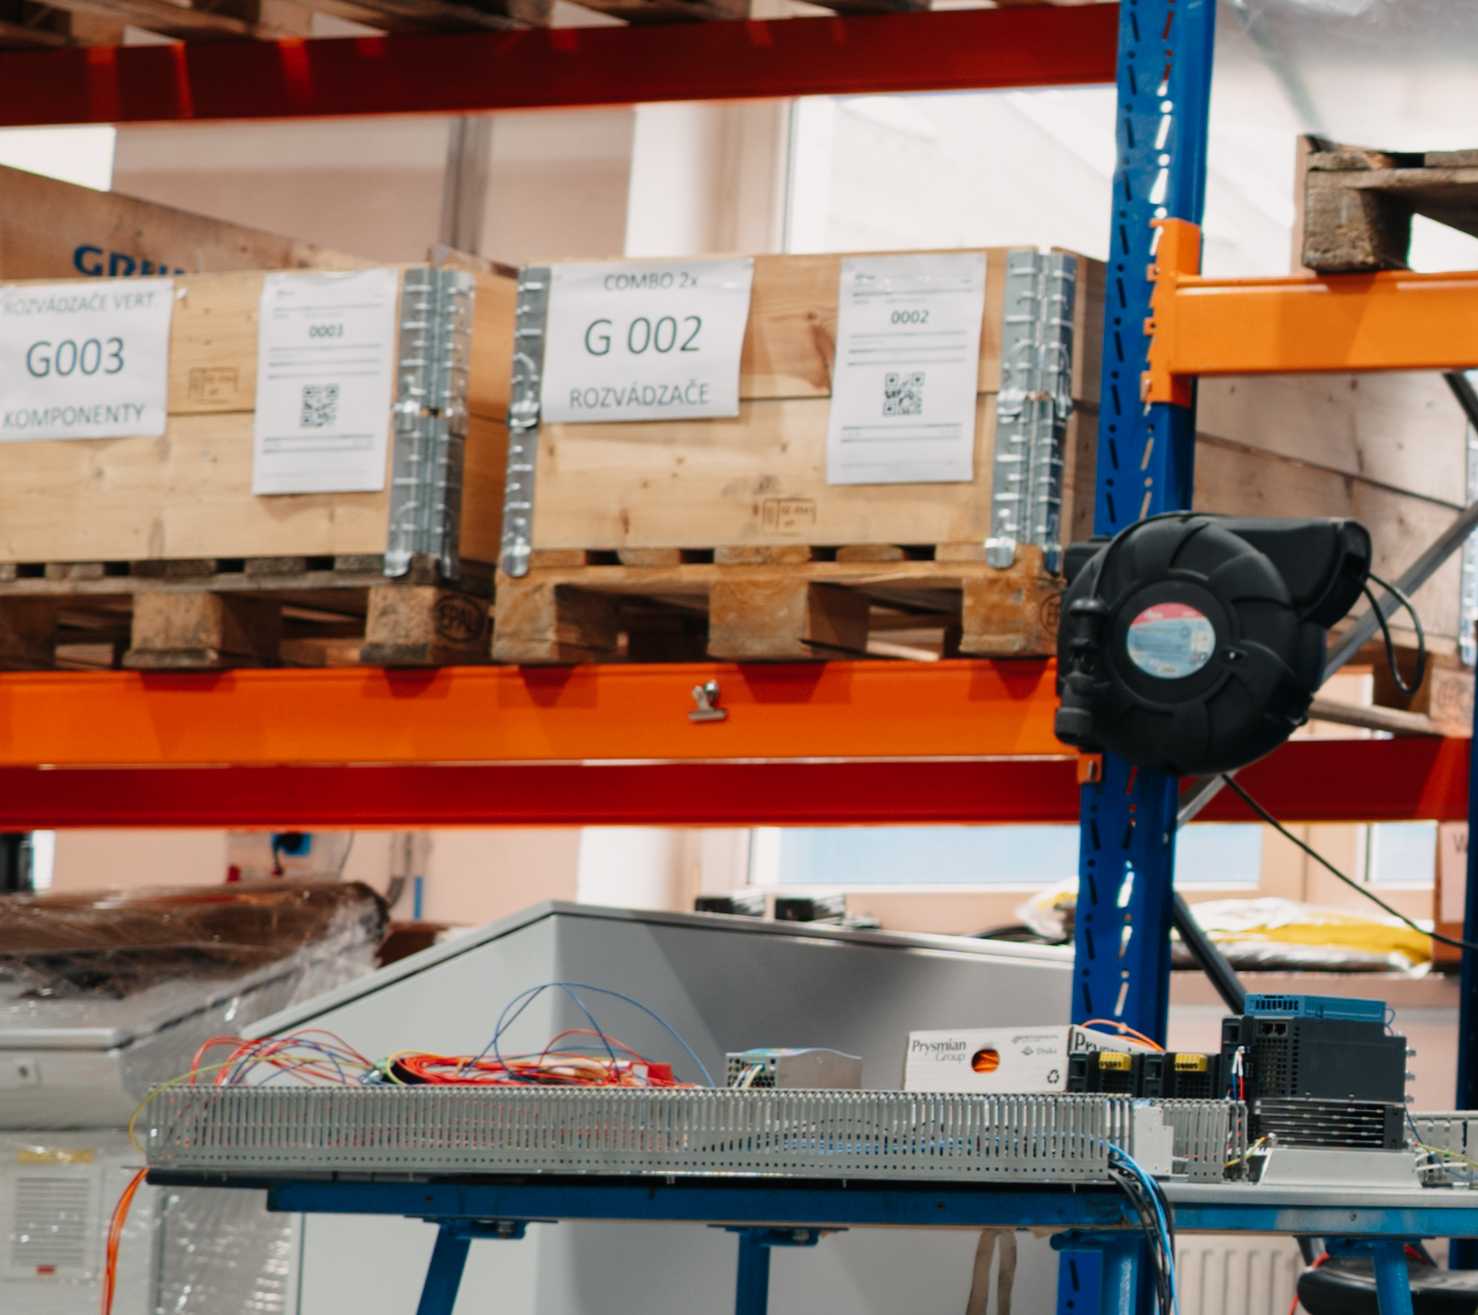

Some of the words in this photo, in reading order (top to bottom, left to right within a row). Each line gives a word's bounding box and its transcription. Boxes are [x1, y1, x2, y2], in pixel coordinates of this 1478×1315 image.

[603, 273, 675, 292] COMBO
[679, 272, 699, 289] 2x
[112, 291, 158, 311] VERT.
[890, 310, 930, 324] 0002
[309, 323, 344, 338] 0003
[584, 318, 612, 357] G
[627, 315, 703, 355] 002
[26, 337, 126, 379] G003
[570, 381, 710, 410] ROZVÁDZAČE
[3, 402, 146, 429] KOMPONENTY
[911, 1038, 967, 1054] Prysmian
[935, 1052, 966, 1063] Group
